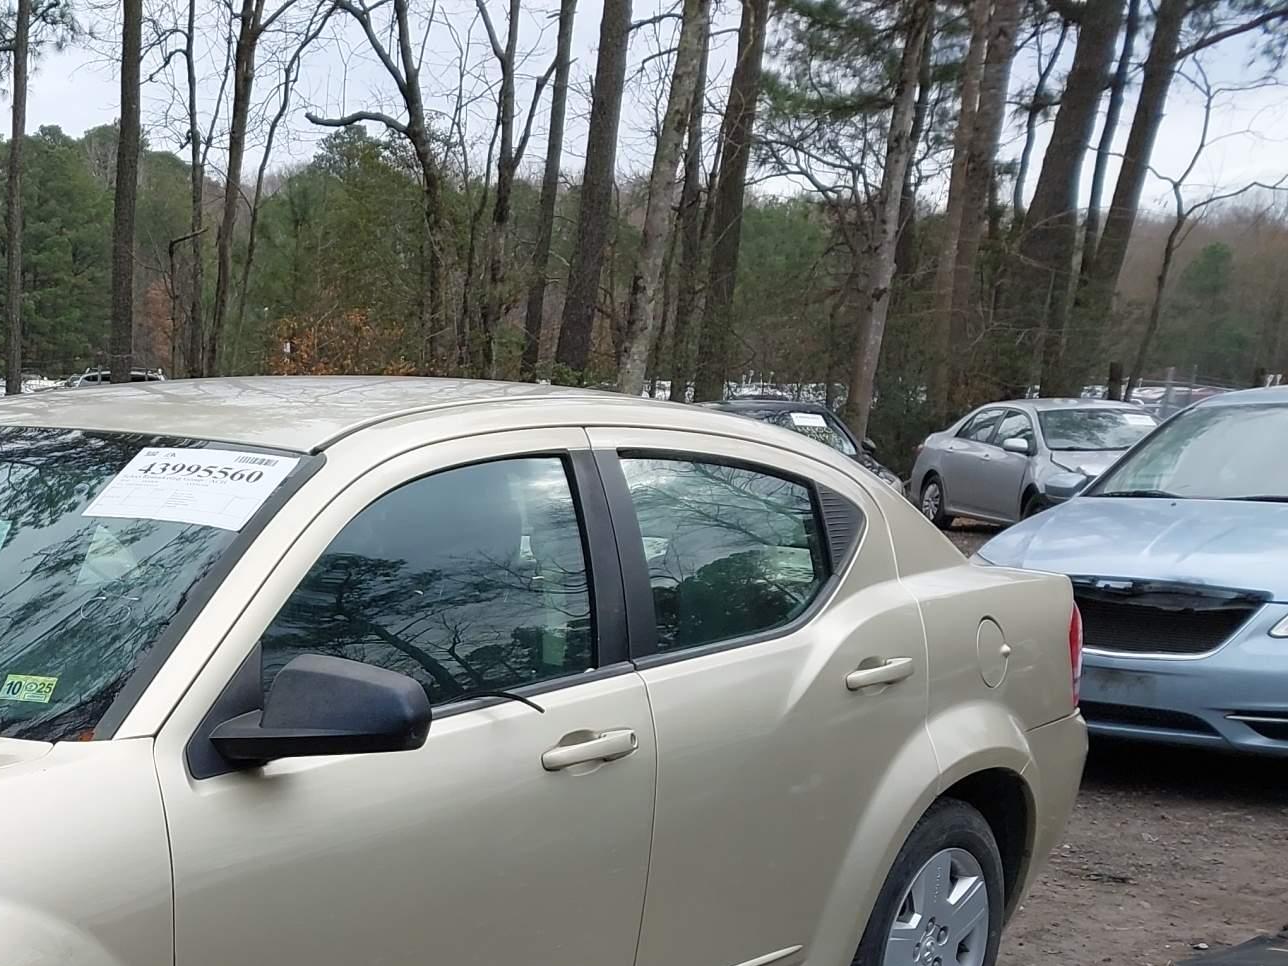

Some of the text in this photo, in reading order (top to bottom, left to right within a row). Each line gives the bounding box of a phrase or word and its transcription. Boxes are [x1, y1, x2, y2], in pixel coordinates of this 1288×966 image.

[138, 462, 264, 483] 43995560
[6, 681, 53, 695] 10 25
